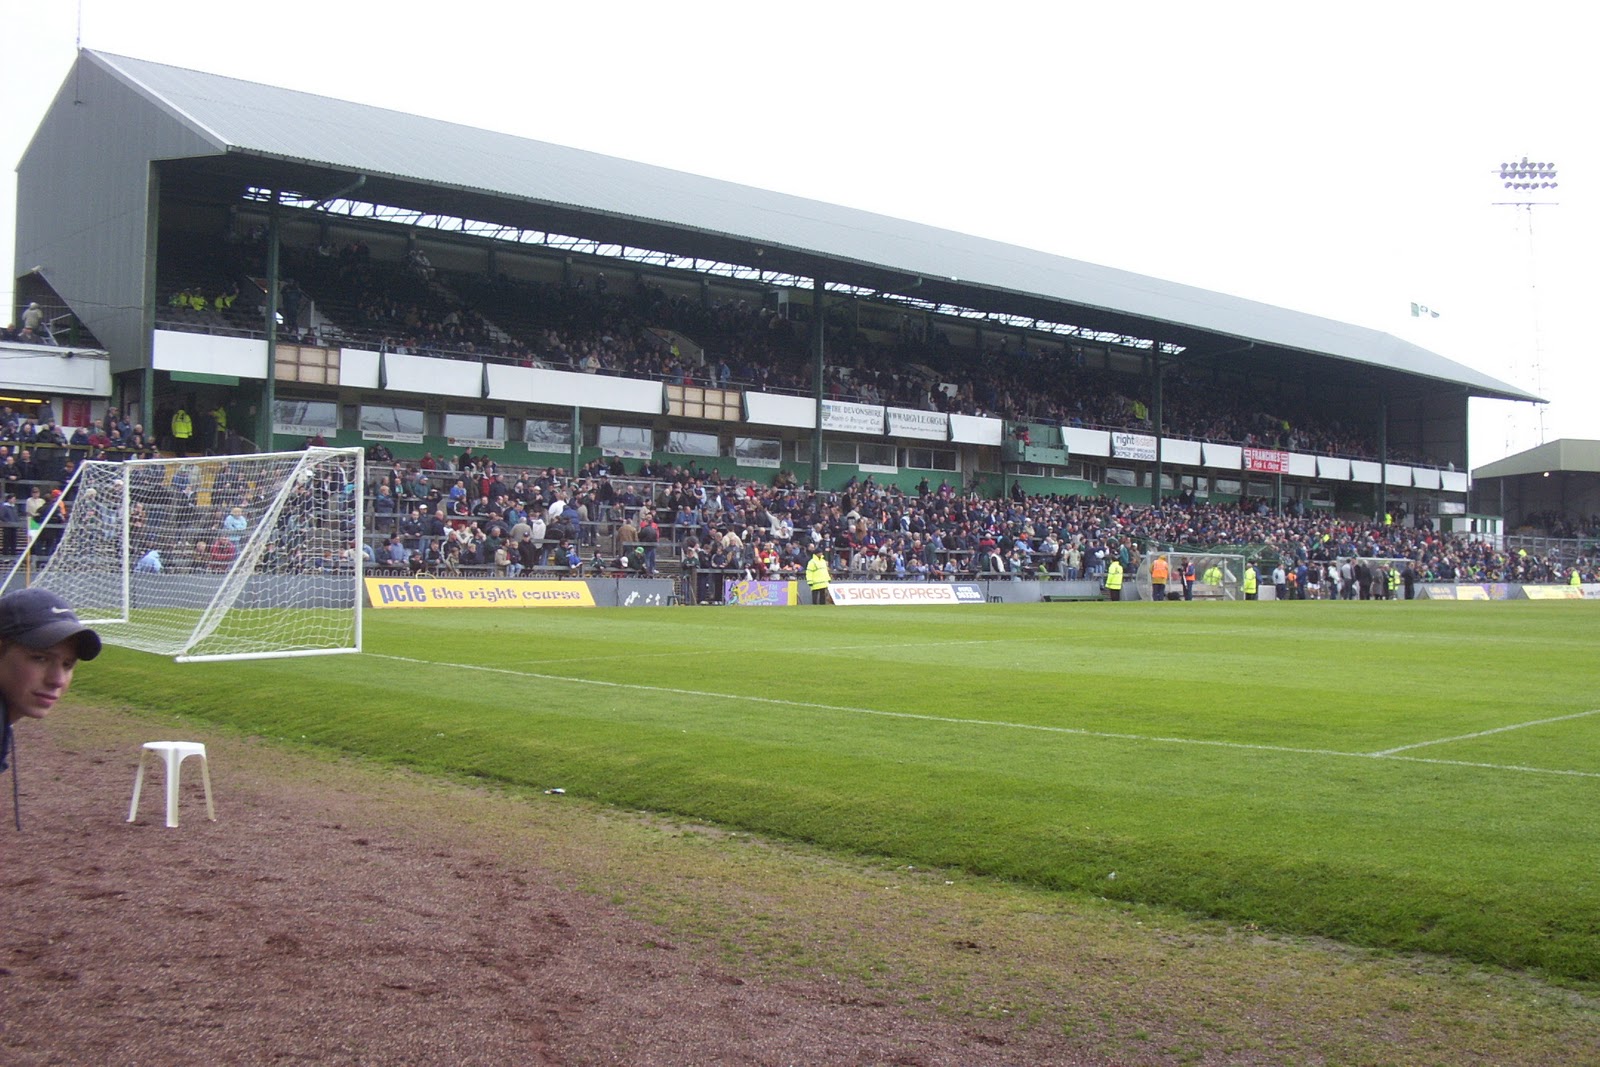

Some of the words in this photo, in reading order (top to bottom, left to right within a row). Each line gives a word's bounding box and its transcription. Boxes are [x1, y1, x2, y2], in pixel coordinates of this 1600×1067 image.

[379, 581, 427, 604] pcfe
[431, 587, 464, 600] the
[468, 587, 517, 603] right
[522, 589, 581, 600] course
[848, 587, 891, 600] SIGNS
[893, 587, 951, 600] EXPRESS
